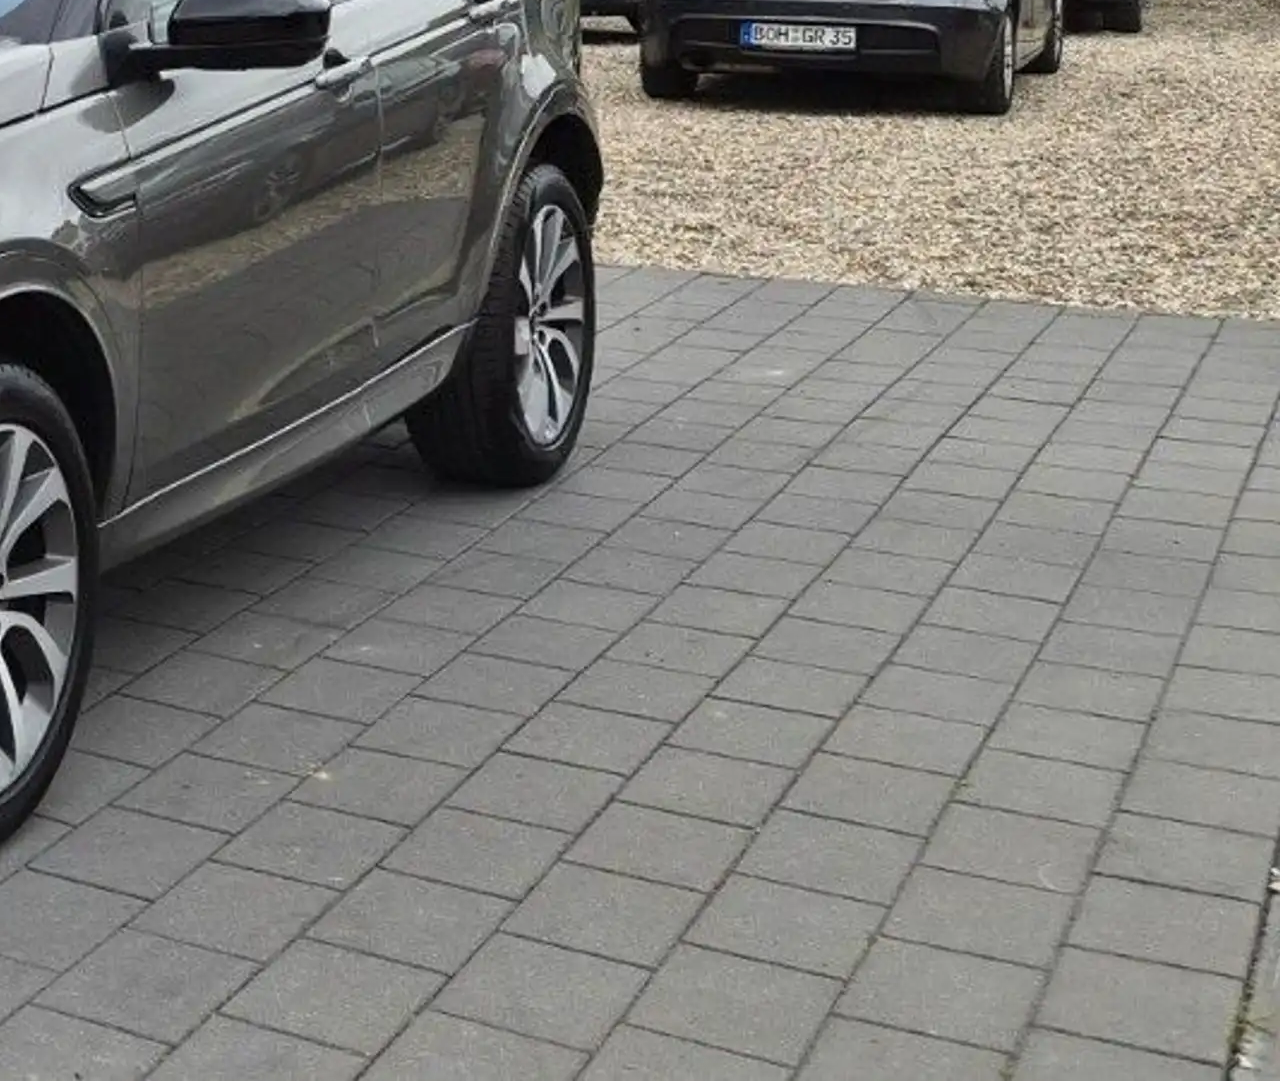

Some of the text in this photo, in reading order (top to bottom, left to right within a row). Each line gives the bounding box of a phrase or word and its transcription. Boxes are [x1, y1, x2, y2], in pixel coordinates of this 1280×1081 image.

[754, 27, 853, 46] BOH GR 35
